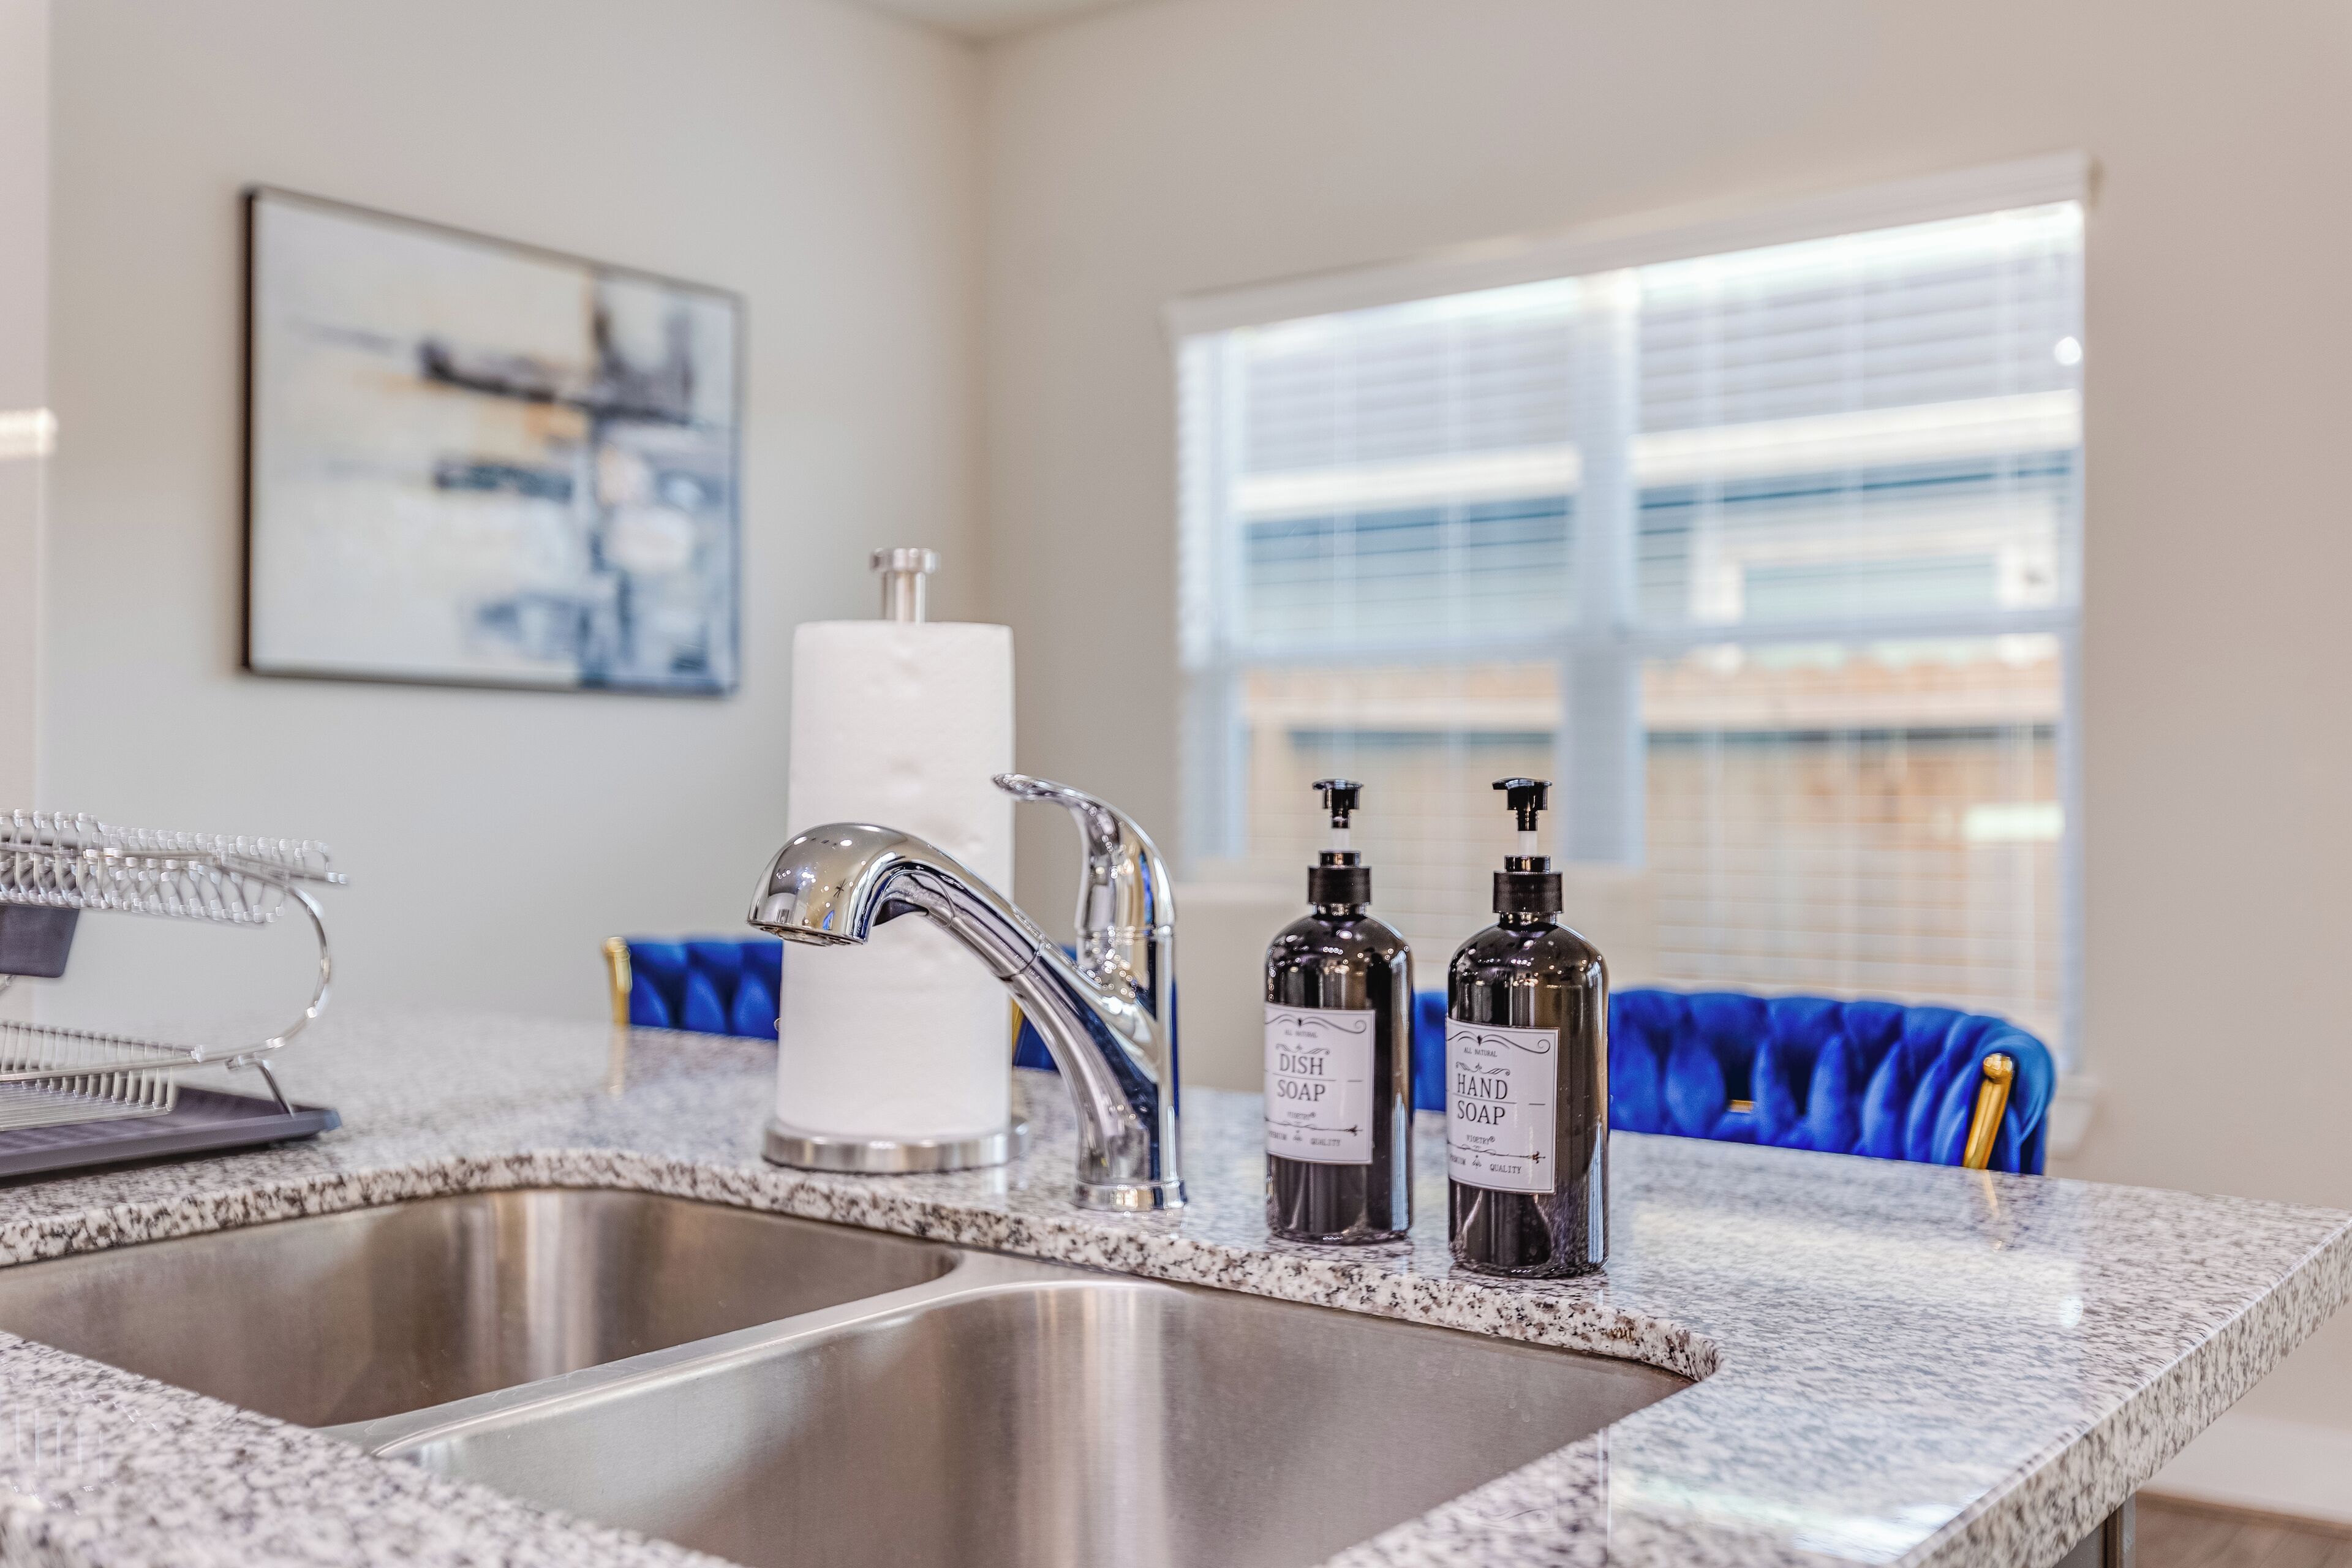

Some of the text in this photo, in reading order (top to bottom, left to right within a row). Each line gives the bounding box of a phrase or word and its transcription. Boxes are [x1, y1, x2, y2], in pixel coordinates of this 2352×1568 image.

[1474, 1049, 1498, 1057] NATURAL
[1279, 1054, 1324, 1076] DISH
[1277, 1079, 1326, 1102] SOAP
[1457, 1072, 1508, 1099] HAND
[1457, 1100, 1506, 1125] SOAP
[1268, 1130, 1341, 1146] PREMIUM QUALITY
[1450, 1153, 1522, 1174] PREMIUM QUALITY
